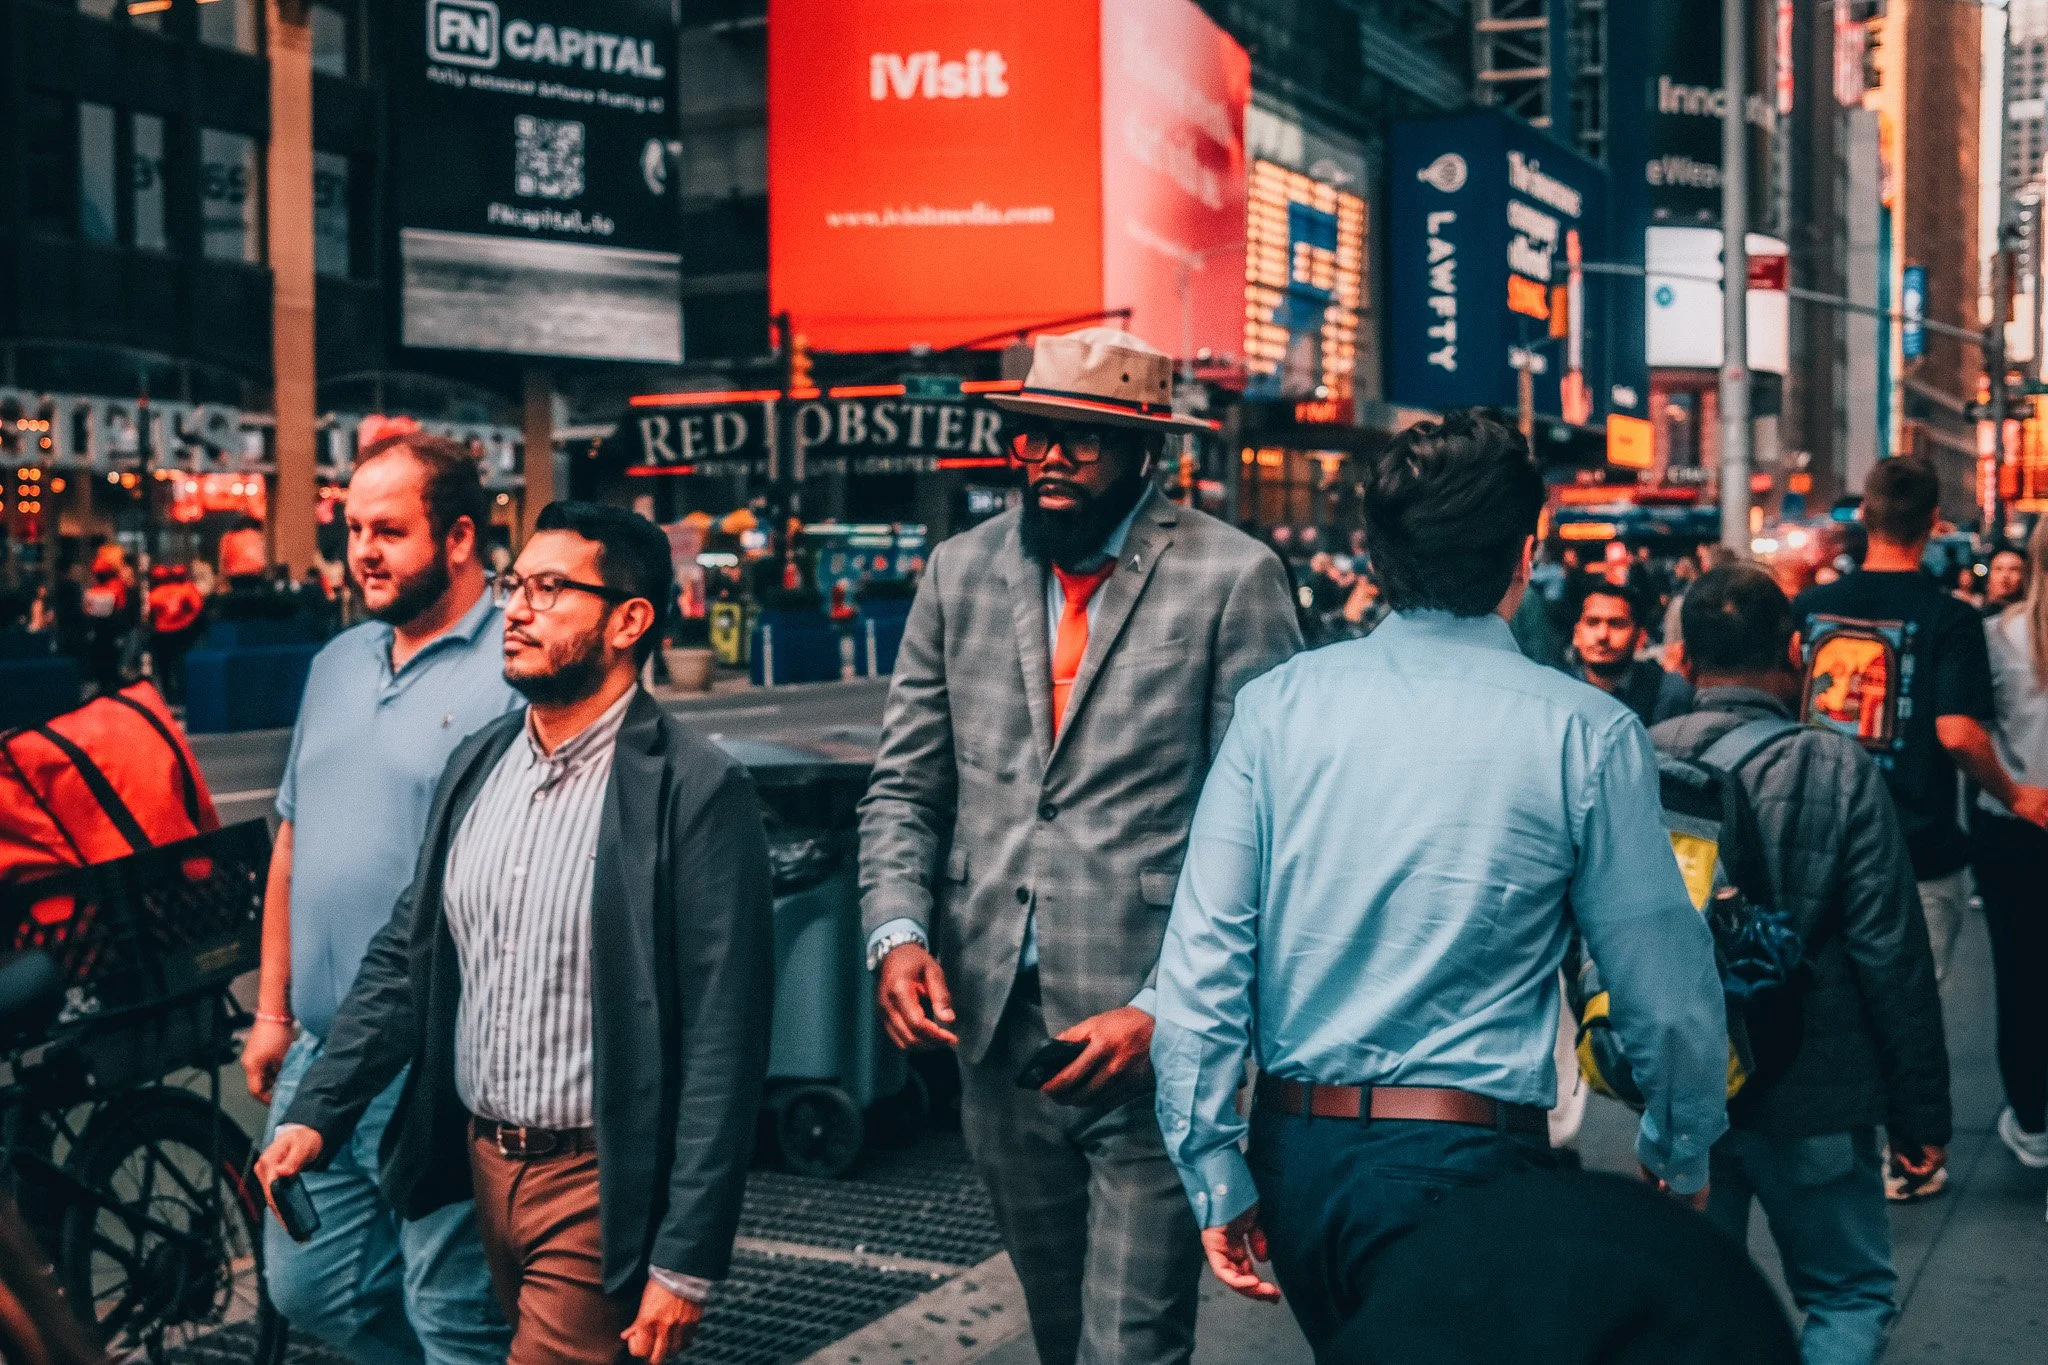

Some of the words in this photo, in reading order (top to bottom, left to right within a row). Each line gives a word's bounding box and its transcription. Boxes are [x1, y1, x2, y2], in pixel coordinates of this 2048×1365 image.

[438, 9, 489, 54] FN
[503, 19, 666, 80] CAPITAL
[1427, 210, 1457, 372] LAWFTY
[638, 411, 749, 466] RED
[766, 400, 1003, 456] OBSTER
